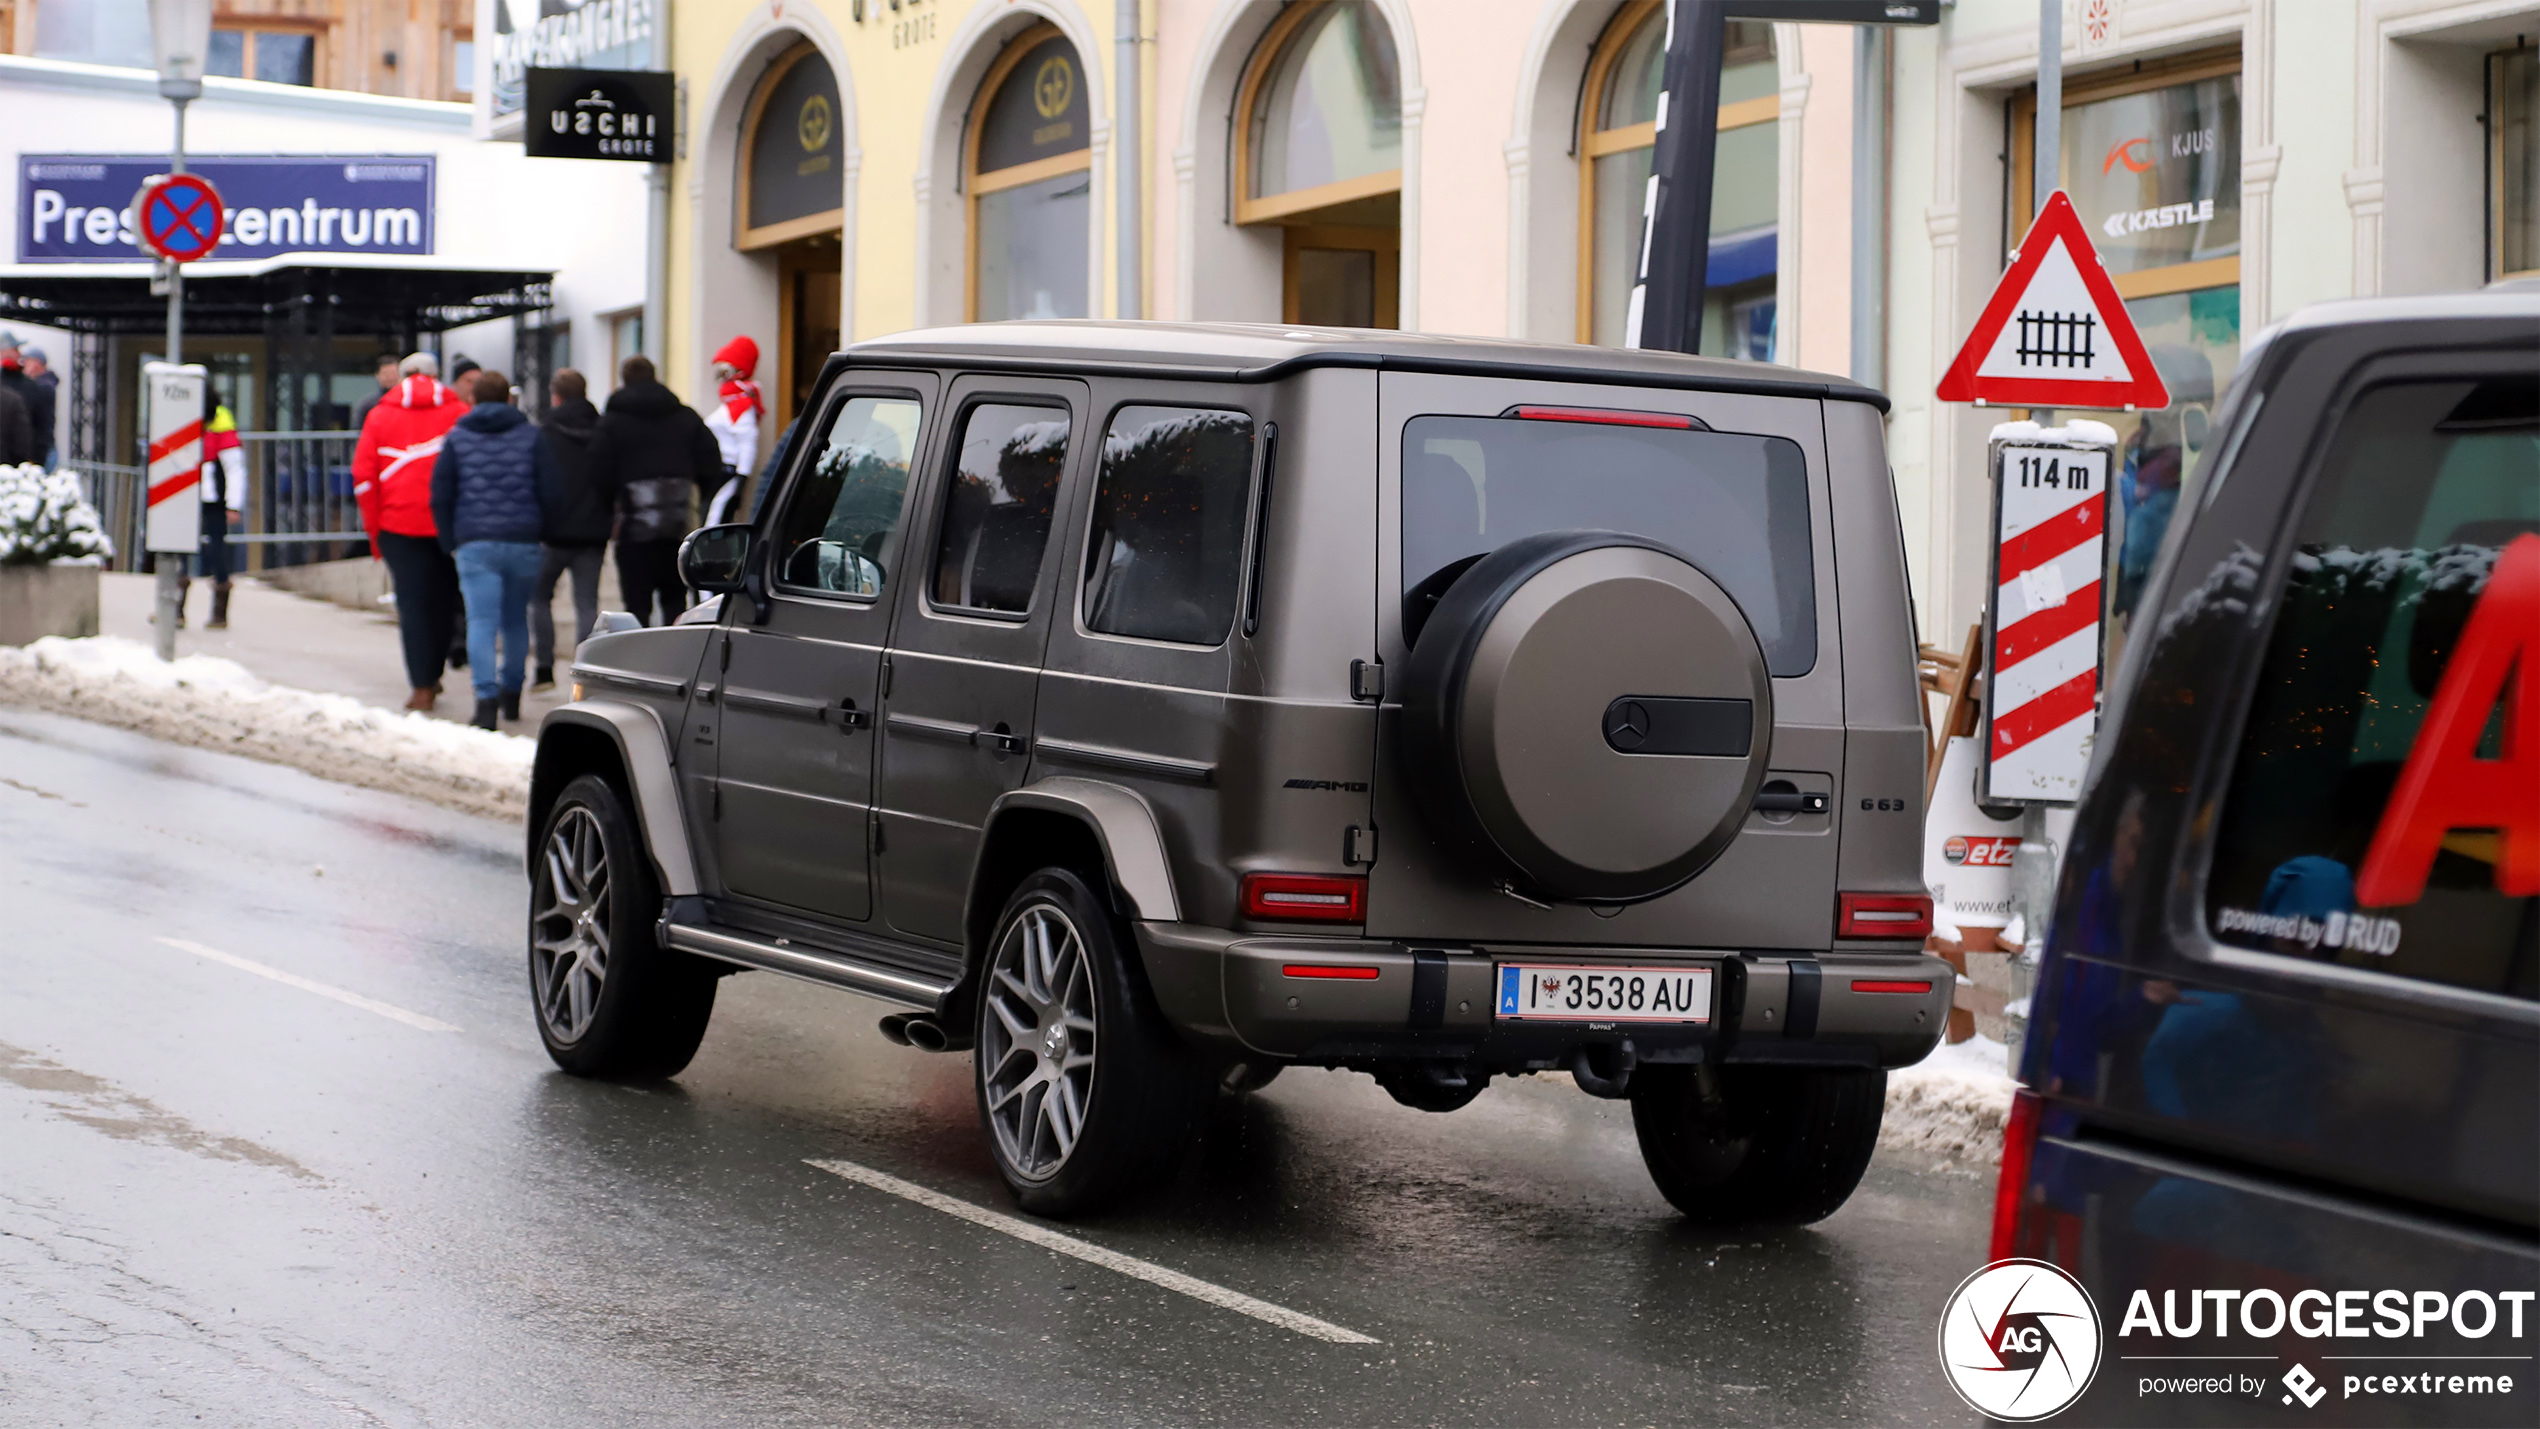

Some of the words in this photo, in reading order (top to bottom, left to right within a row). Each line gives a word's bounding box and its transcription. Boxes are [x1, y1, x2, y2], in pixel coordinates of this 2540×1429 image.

[598, 138, 655, 156] GROTE
[2172, 128, 2214, 158] KJUS
[2019, 457, 2060, 488] 114
[2068, 467, 2088, 490] m
[1861, 799, 1874, 811] G
[1878, 799, 1904, 811] 63
[2217, 907, 2299, 941] powered
[2299, 917, 2326, 949] by
[2347, 913, 2401, 956] RUD
[1505, 997, 1514, 1008] A
[1566, 975, 1645, 1011] 3538
[1652, 978, 1694, 1012] AU
